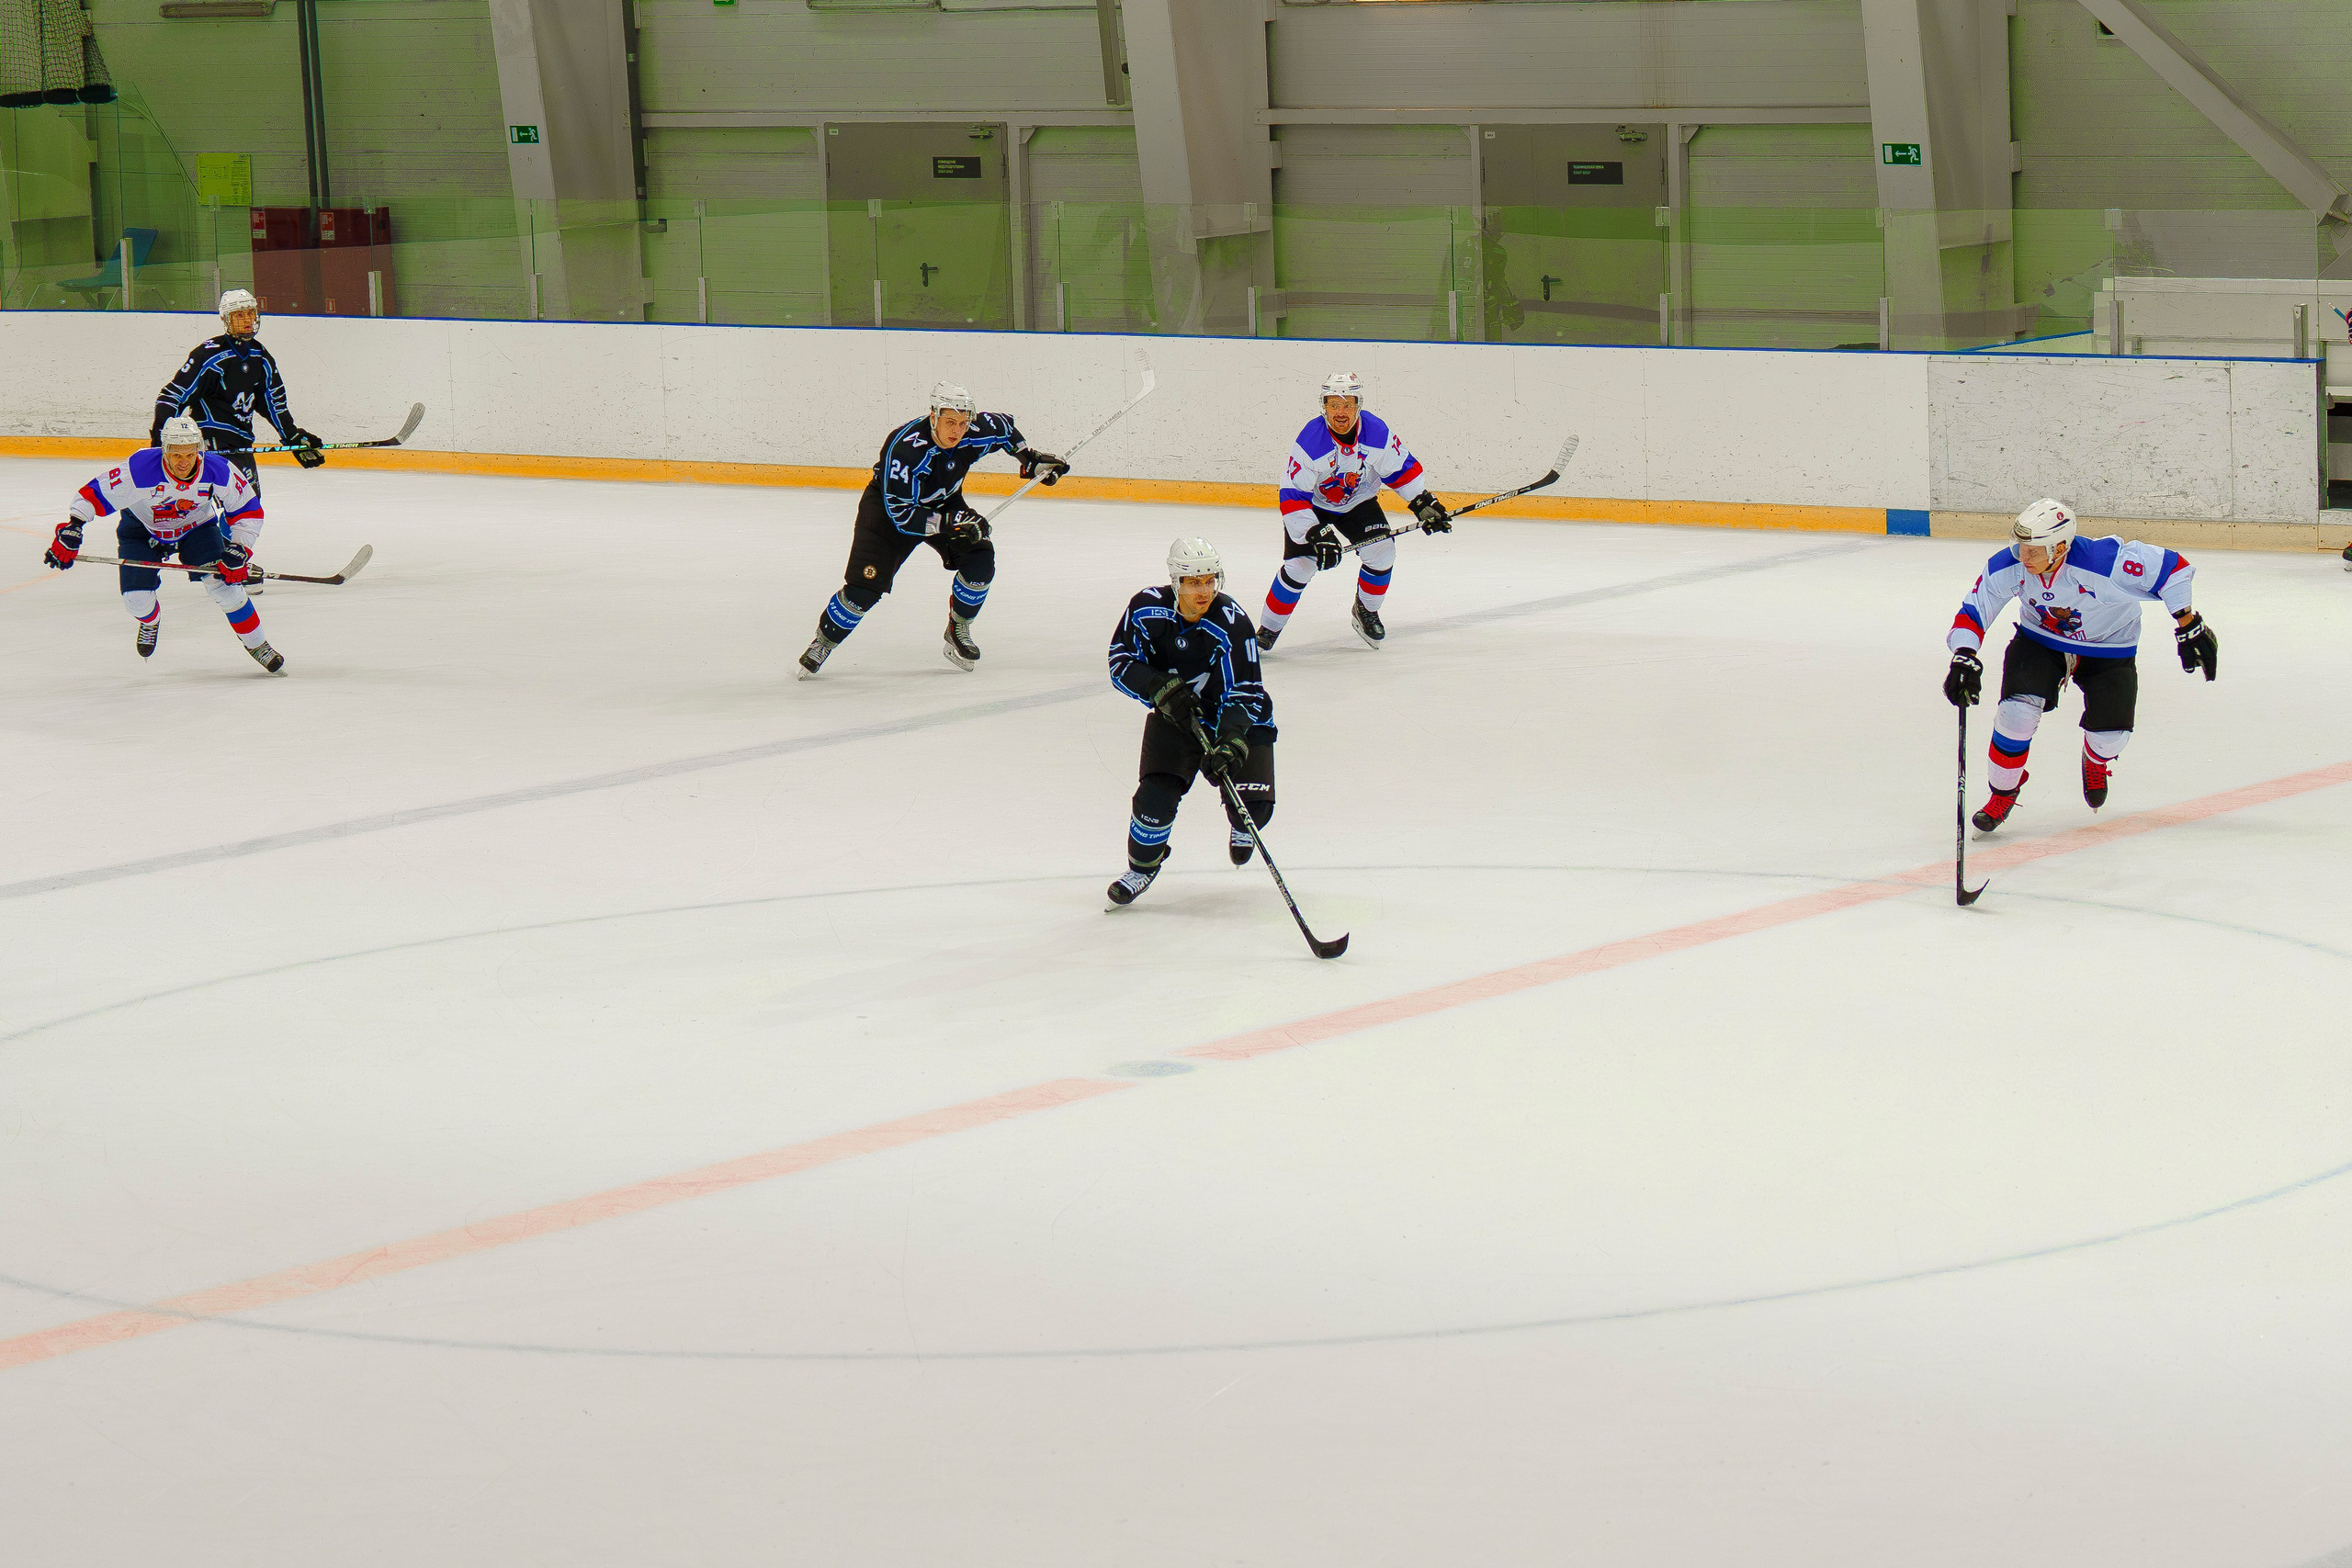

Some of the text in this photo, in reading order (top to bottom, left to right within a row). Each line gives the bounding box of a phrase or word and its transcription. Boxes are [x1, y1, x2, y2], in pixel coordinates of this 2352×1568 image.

[1105, 410, 1123, 425] TIMER
[108, 467, 123, 490] 81
[889, 459, 910, 484] 24
[1475, 491, 1519, 510] ONE TIMER
[61, 529, 83, 538] BAU
[1364, 523, 1392, 533] BAU
[1342, 535, 1387, 553] DOMINATOR
[224, 547, 245, 559] UER
[2122, 559, 2143, 577] 8
[1244, 637, 1258, 663] 11
[1952, 655, 1982, 671] CM
[1235, 783, 1271, 792] CCM
[1133, 827, 1148, 839] ONE
